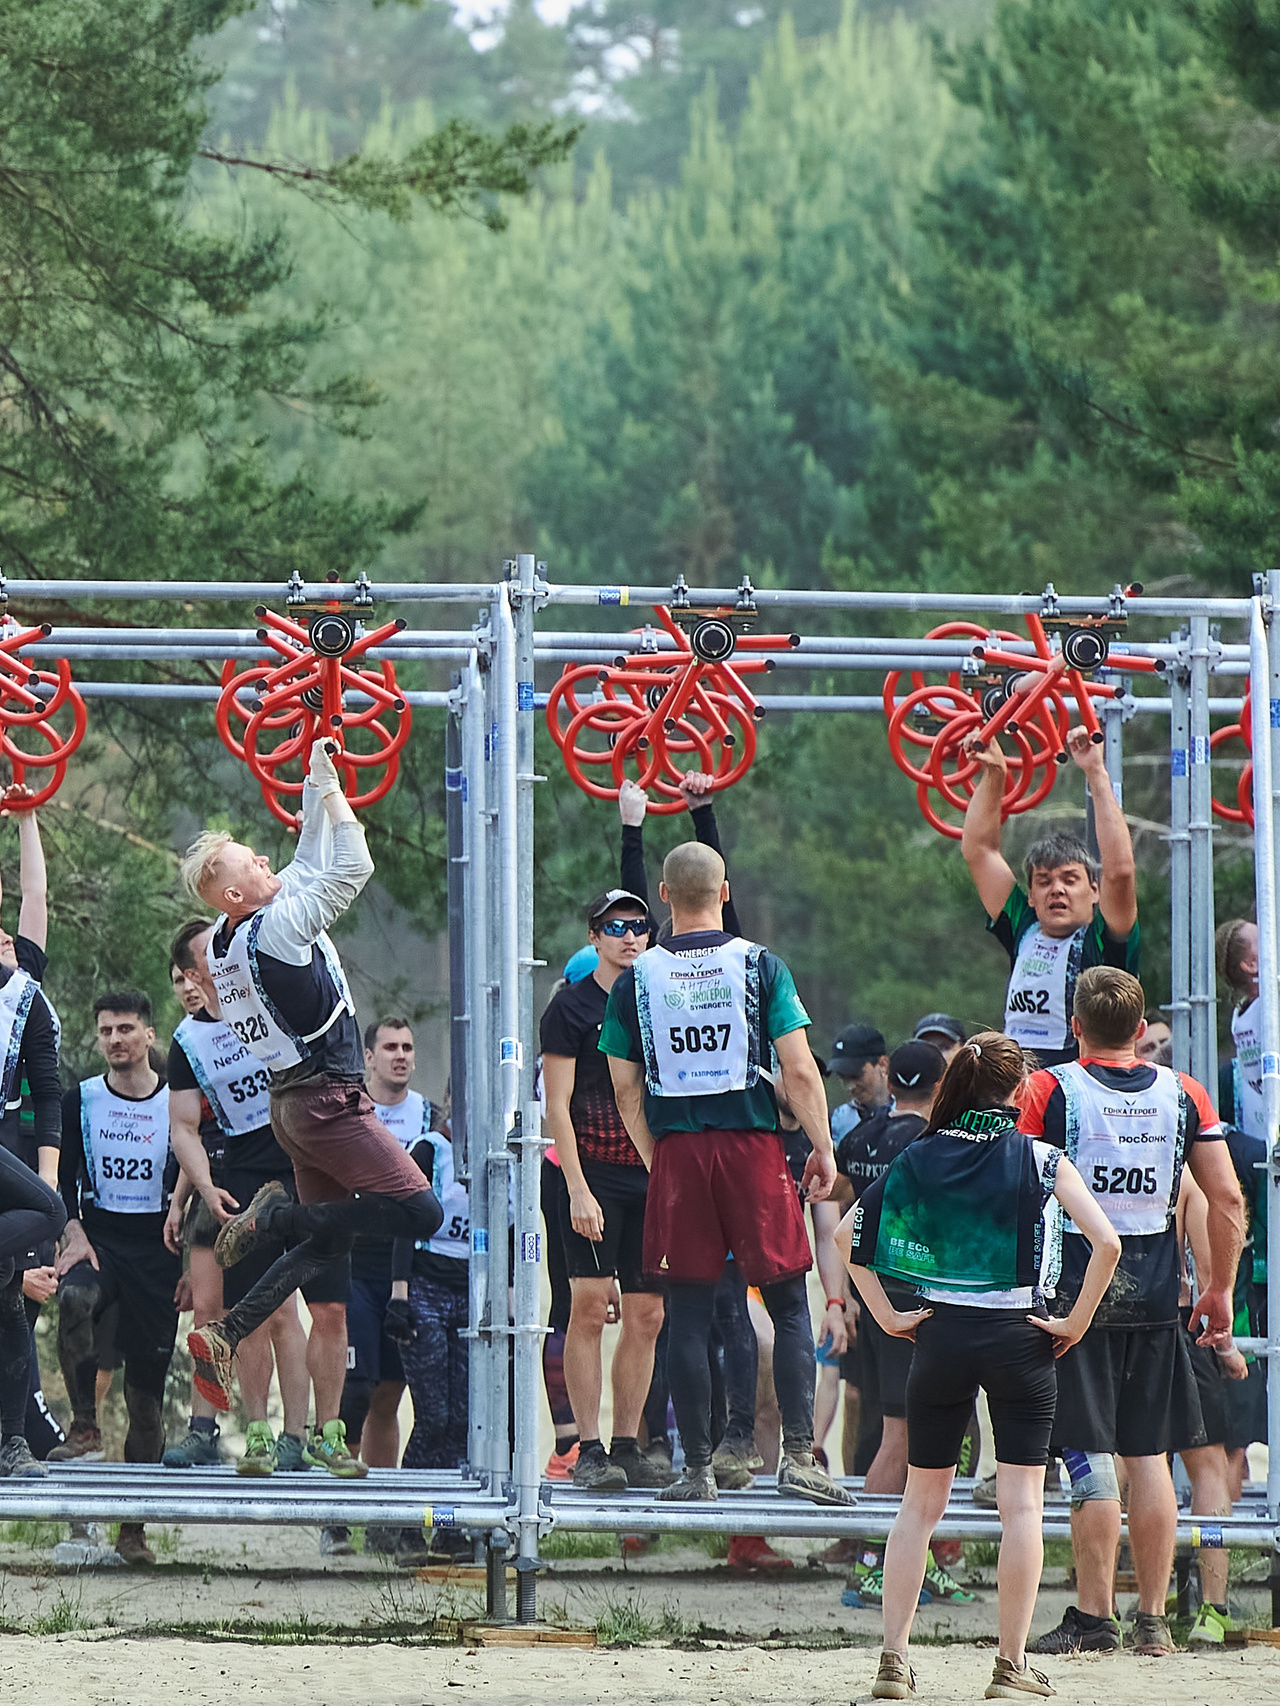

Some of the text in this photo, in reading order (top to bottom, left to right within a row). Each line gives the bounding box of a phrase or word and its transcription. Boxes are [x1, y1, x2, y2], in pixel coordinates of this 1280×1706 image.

[690, 1001, 732, 1011] SYNERGETIC
[228, 1013, 269, 1044] 326
[670, 1024, 731, 1054] 5037
[99, 1128, 159, 1146] Neoflex
[102, 1156, 153, 1180] 5323
[1092, 1165, 1158, 1195] 5205
[851, 1207, 865, 1248] BE ECO
[889, 1237, 930, 1253] BE ECO
